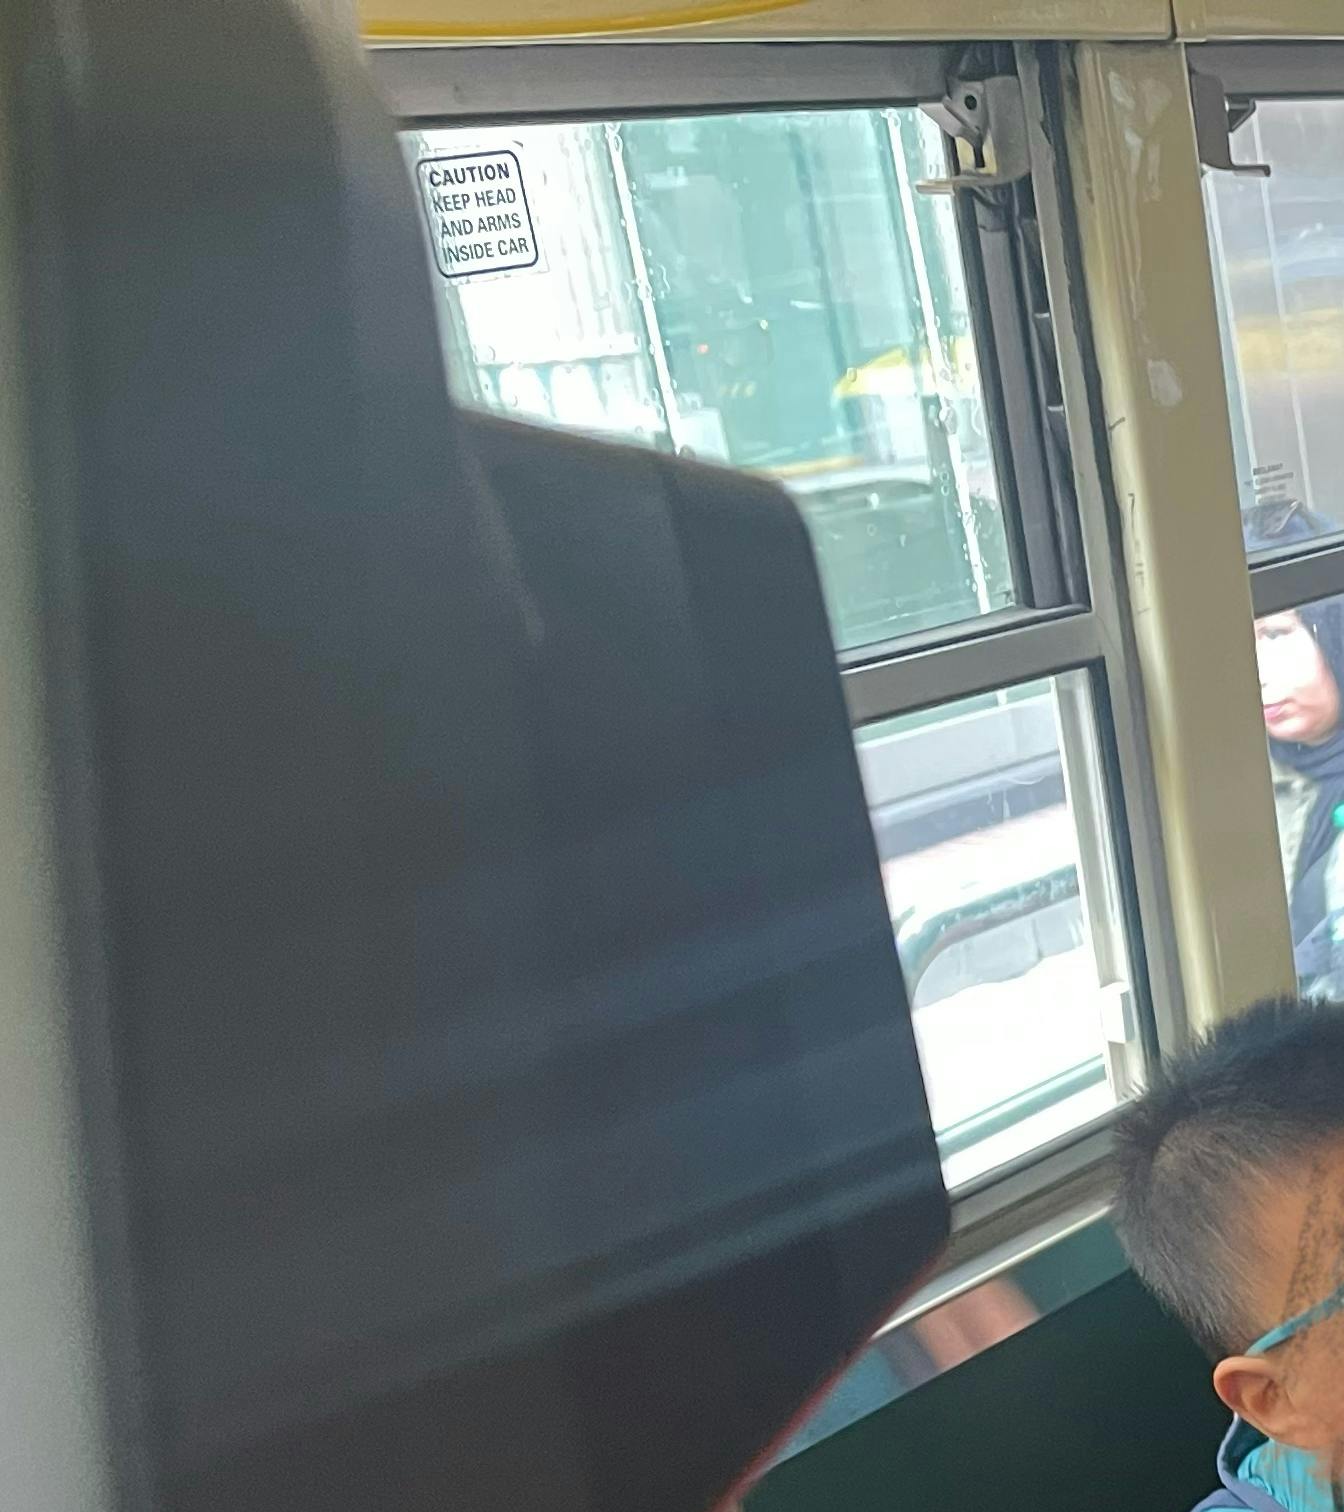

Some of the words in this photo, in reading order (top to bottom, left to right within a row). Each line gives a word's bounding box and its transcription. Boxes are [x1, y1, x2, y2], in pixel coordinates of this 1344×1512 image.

[430, 162, 510, 187] CAUTION
[432, 193, 470, 213] KEEP
[474, 188, 516, 208] HEAD
[440, 218, 473, 239] AND
[477, 212, 521, 233] ARMS
[442, 241, 494, 264] INSIDE
[498, 237, 529, 256] CAR
